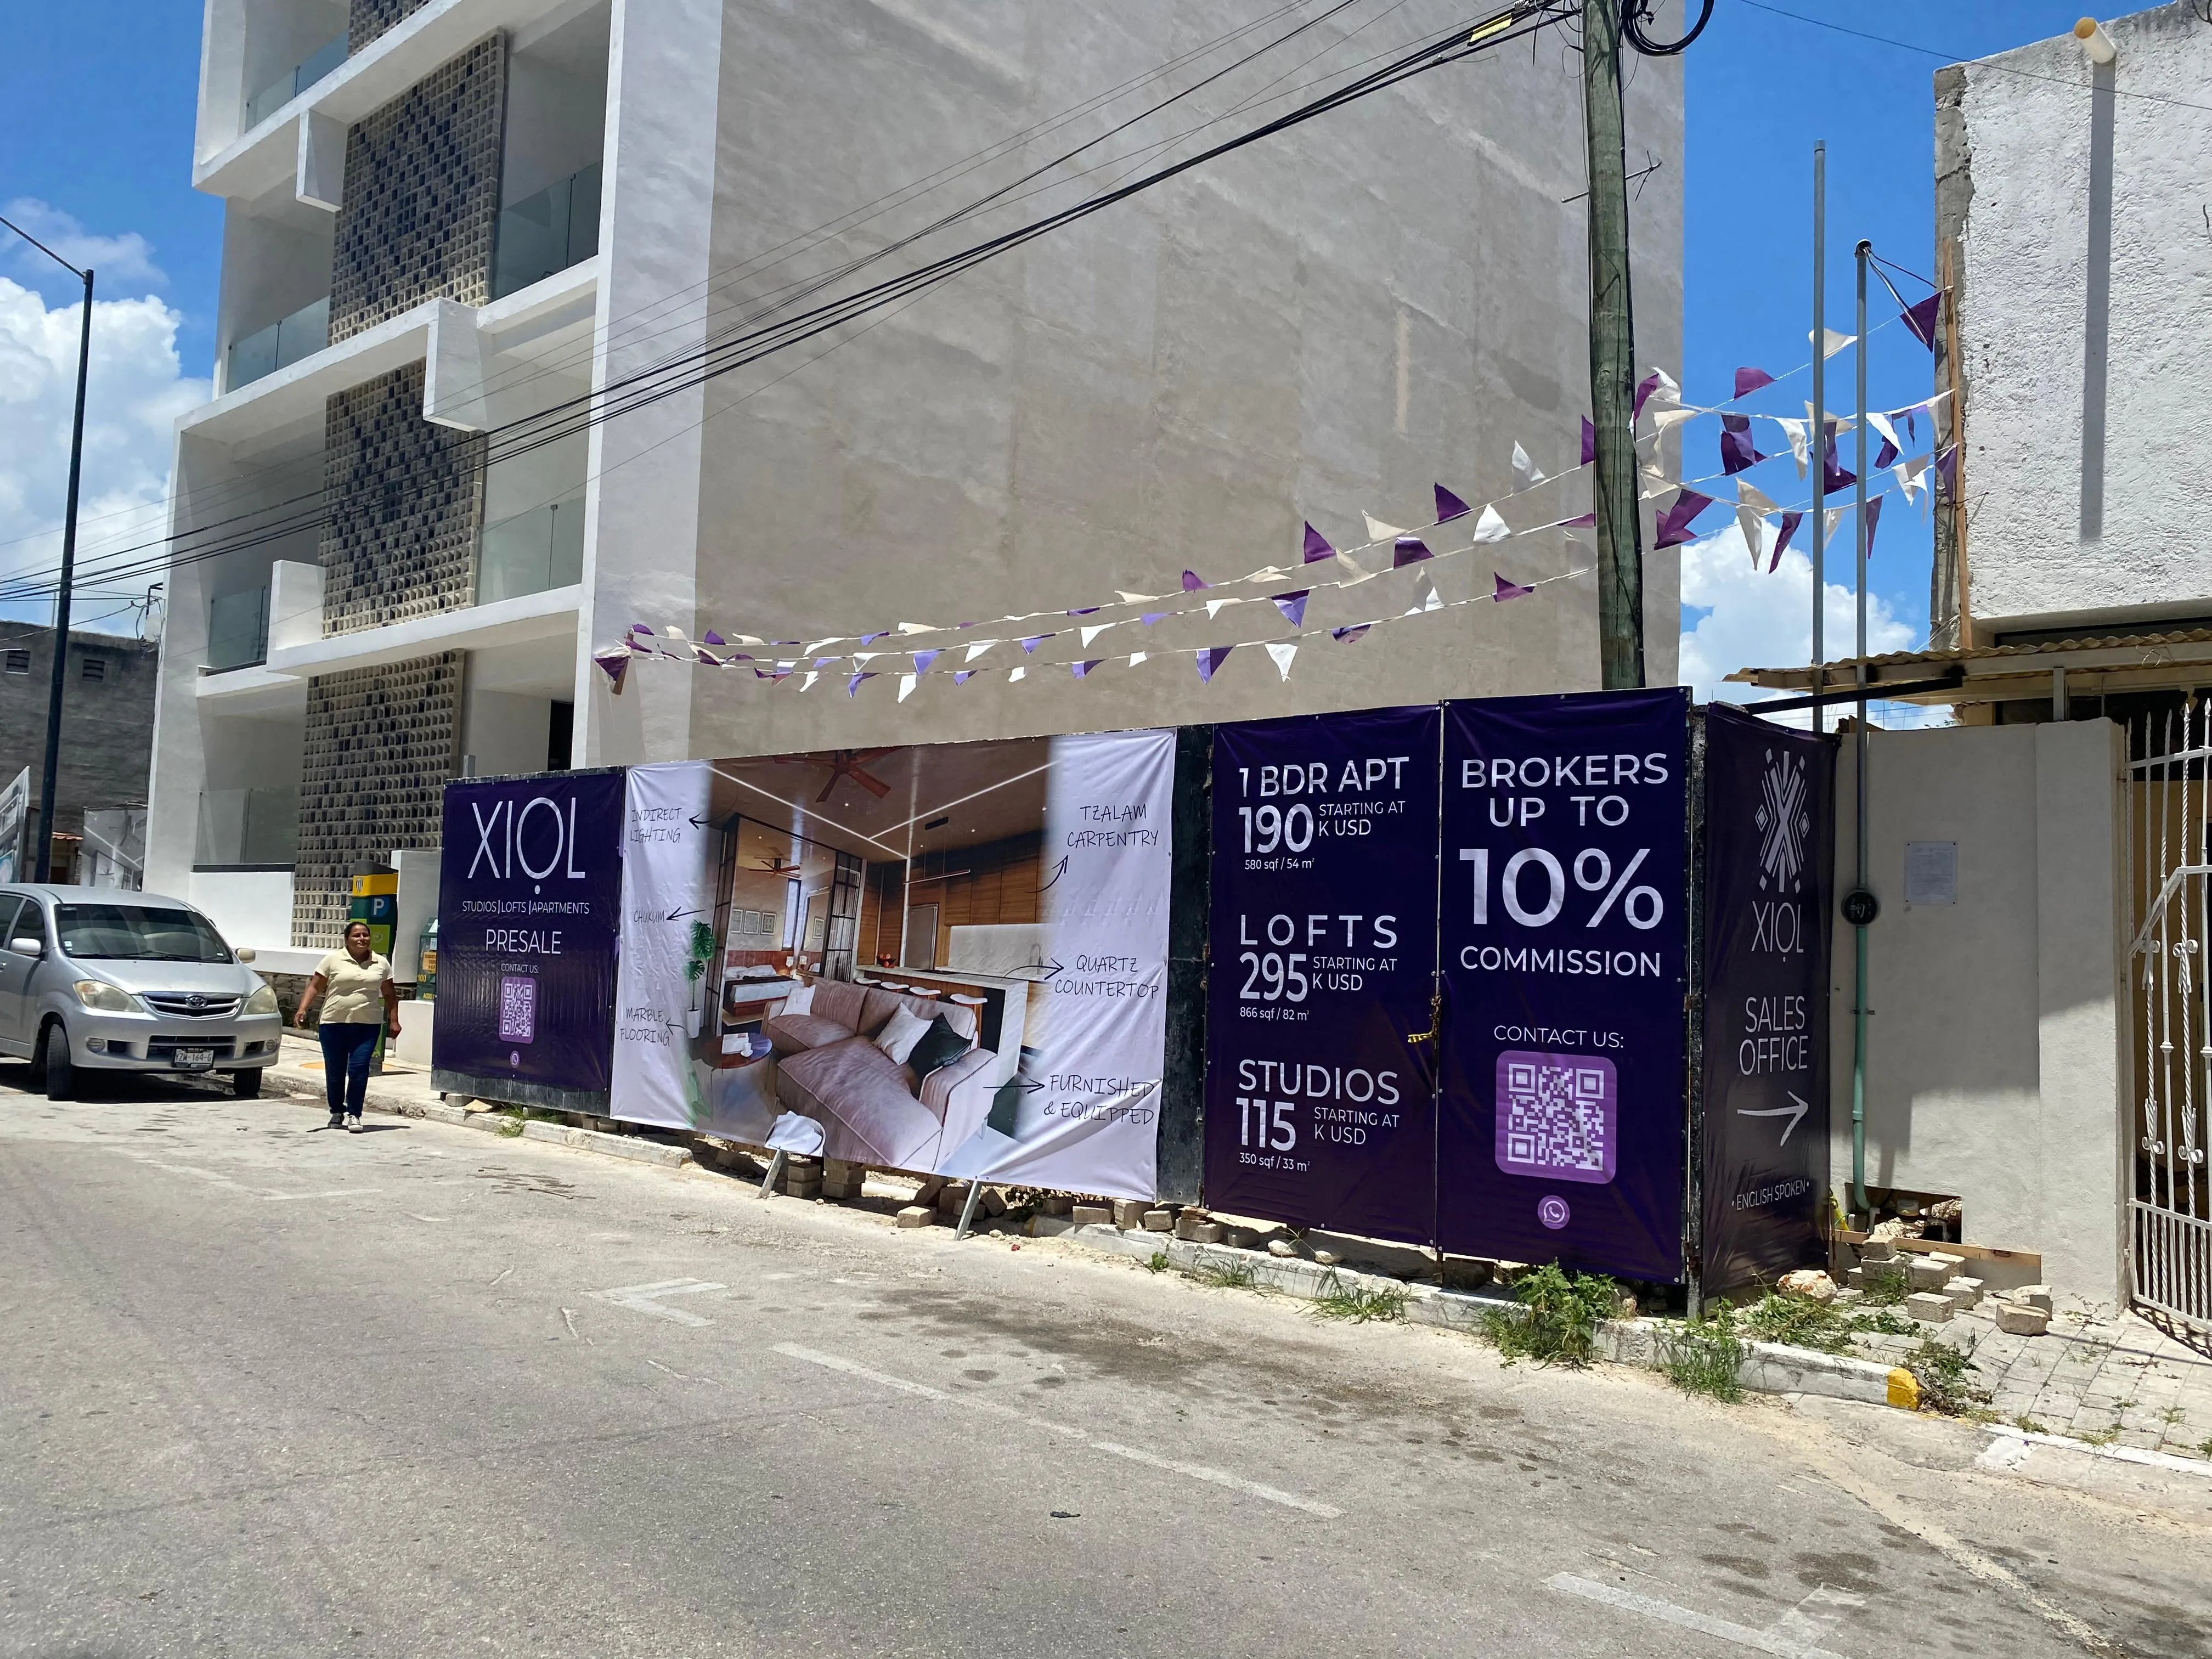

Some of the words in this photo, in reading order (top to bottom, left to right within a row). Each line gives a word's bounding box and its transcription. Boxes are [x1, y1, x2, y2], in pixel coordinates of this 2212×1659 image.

[1239, 768, 1249, 797] 1
[1260, 762, 1328, 797] BDR
[1338, 756, 1409, 792] APT
[1462, 753, 1668, 788] BROKERS
[631, 808, 682, 822] INDIRECT
[1080, 803, 1147, 822] TZALAM
[1489, 797, 1545, 827] UP
[1570, 795, 1629, 826] TO
[629, 827, 681, 844] LIGHTING
[1239, 803, 1314, 853] 190
[1319, 802, 1384, 816] STARTING
[1387, 800, 1406, 814] AT
[1319, 820, 1329, 837] K
[1335, 819, 1371, 836] USD
[1067, 830, 1159, 849] CARPENTRY
[1245, 859, 1262, 870] 580
[1264, 858, 1279, 872] sqf
[1286, 858, 1299, 869] 54
[1459, 848, 1663, 929] 10%
[374, 898, 384, 916] P
[486, 929, 562, 955] PRESALE
[501, 963, 528, 973] CONTACT
[1076, 954, 1138, 973] QUARTZ
[1460, 946, 1660, 977] COMMISSION
[1055, 977, 1159, 1000] COUNTERTOP
[1239, 952, 1308, 1002] 295
[1313, 956, 1375, 970] STARTING
[1379, 958, 1398, 971] AT
[1313, 973, 1323, 989] K
[1328, 973, 1363, 991] USD
[626, 1007, 664, 1022] MARBLE
[1240, 1006, 1257, 1018] 866
[1260, 1007, 1275, 1021] sqf
[1283, 1009, 1295, 1020] 82
[1745, 996, 1805, 1033] SALES
[620, 1028, 670, 1047] FLOORING
[1494, 1025, 1587, 1046] CONTACT
[1593, 1031, 1624, 1048] US:
[1739, 1035, 1808, 1075] OFFICE
[1050, 1074, 1154, 1098] FURNISHED
[1238, 1058, 1401, 1105] STUDIOS
[1044, 1102, 1056, 1116] &
[1061, 1103, 1154, 1125] EQUIPPED
[1235, 1097, 1296, 1152] 115
[1313, 1107, 1378, 1126] STARTING
[1381, 1114, 1401, 1128] AT
[1314, 1123, 1325, 1140] K
[1331, 1125, 1366, 1145] USD
[1239, 1152, 1257, 1165] 350
[1259, 1155, 1274, 1169] sqf
[1283, 1158, 1294, 1170] 33
